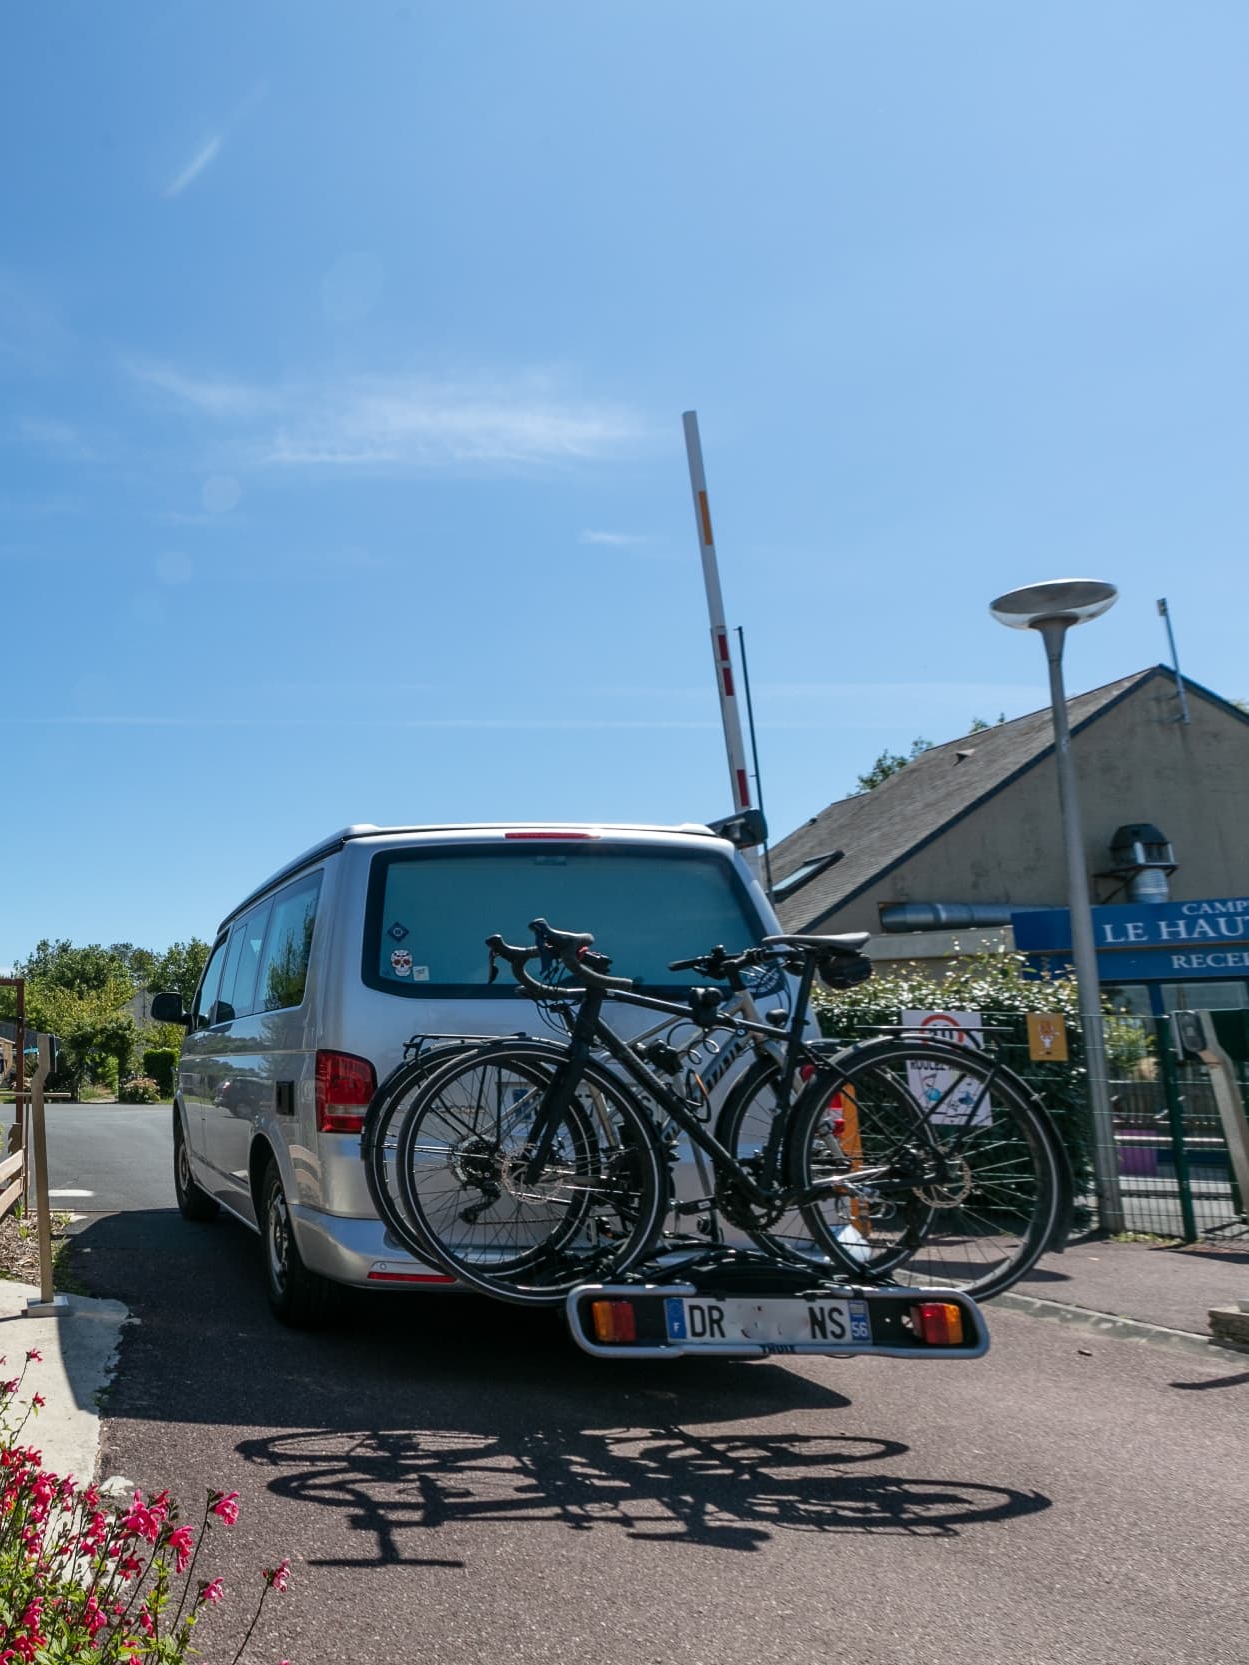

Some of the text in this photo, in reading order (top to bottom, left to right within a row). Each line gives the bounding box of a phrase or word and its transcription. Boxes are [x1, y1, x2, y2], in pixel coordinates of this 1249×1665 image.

[1182, 900, 1249, 915] CAMP
[1102, 916, 1249, 943] LE HAU
[688, 1304, 726, 1339] DR
[808, 1306, 847, 1340] NS
[852, 1321, 868, 1338] 56
